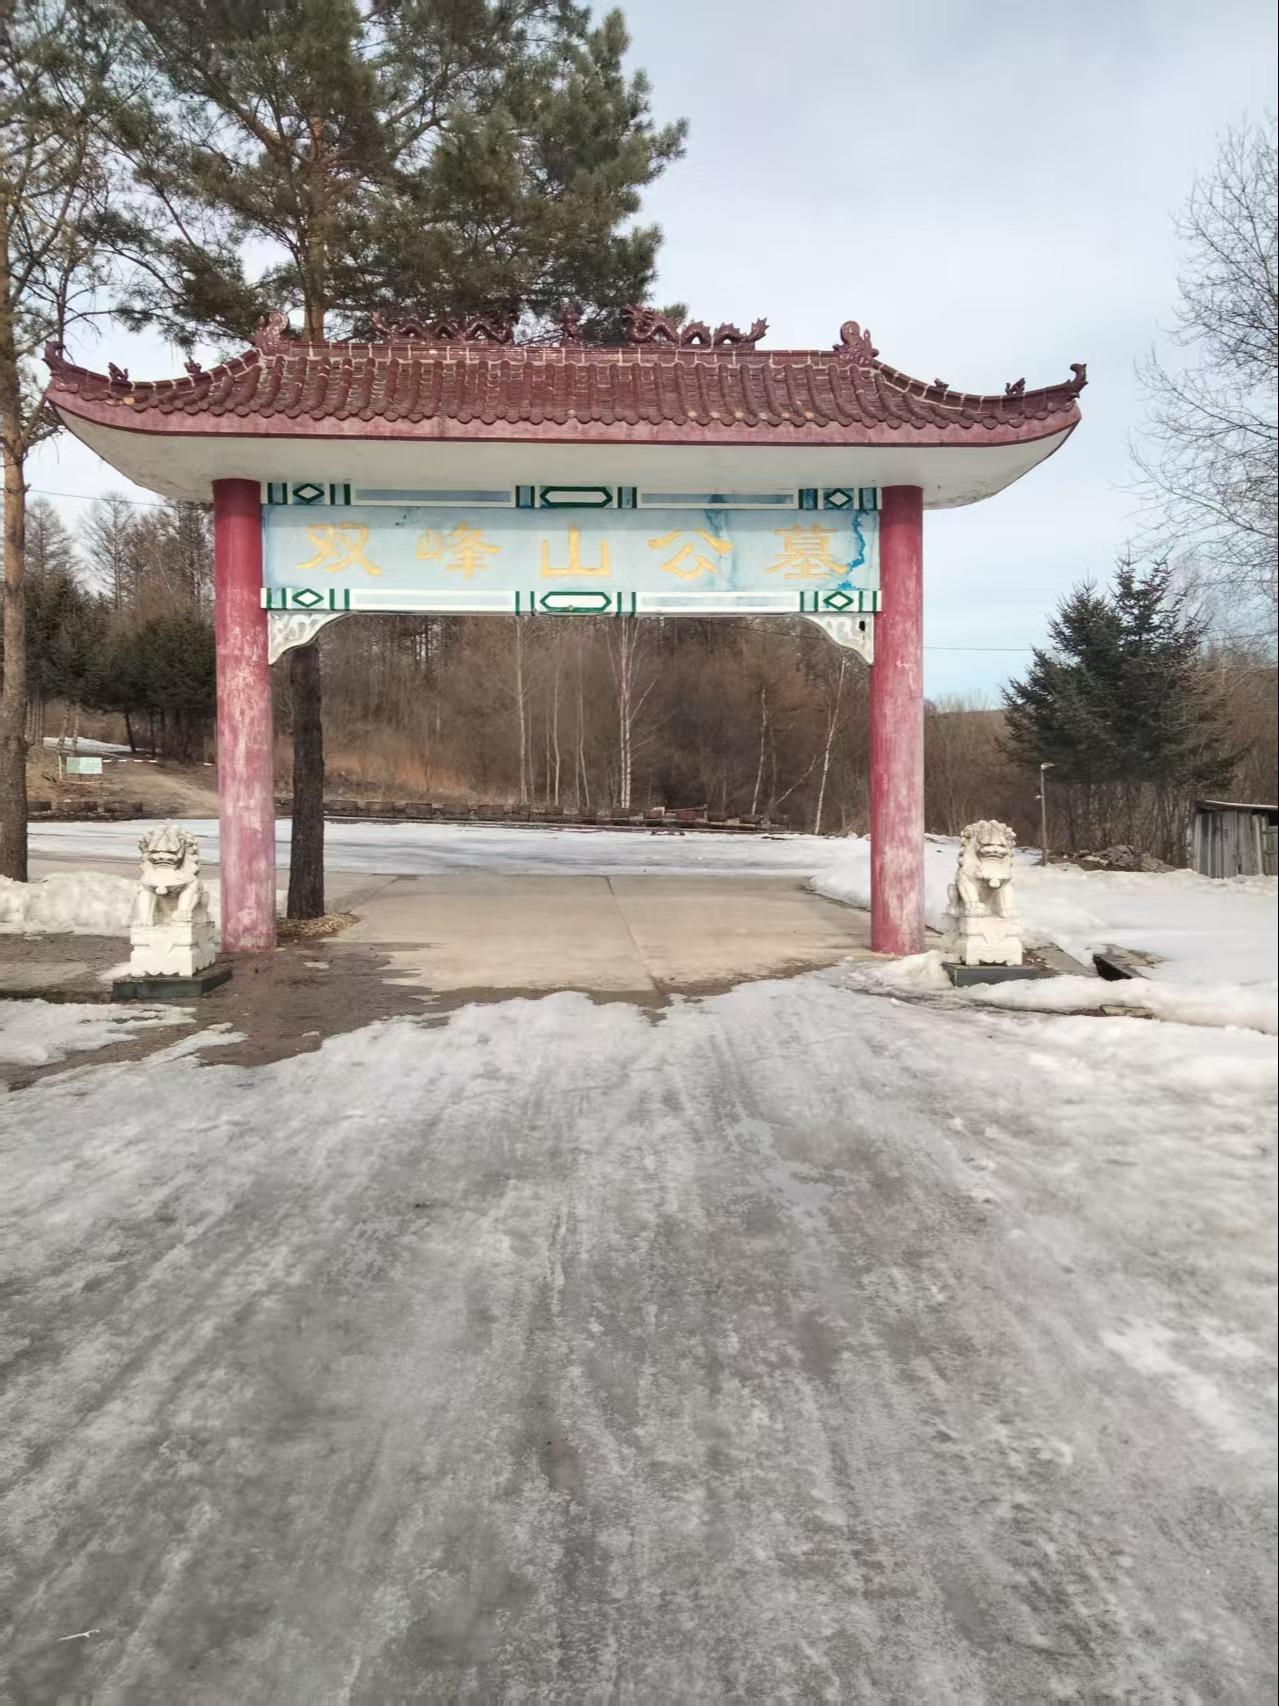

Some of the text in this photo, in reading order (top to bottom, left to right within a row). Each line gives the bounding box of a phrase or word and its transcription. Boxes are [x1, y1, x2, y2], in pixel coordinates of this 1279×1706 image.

[295, 521, 849, 579] 双峰山公墓
